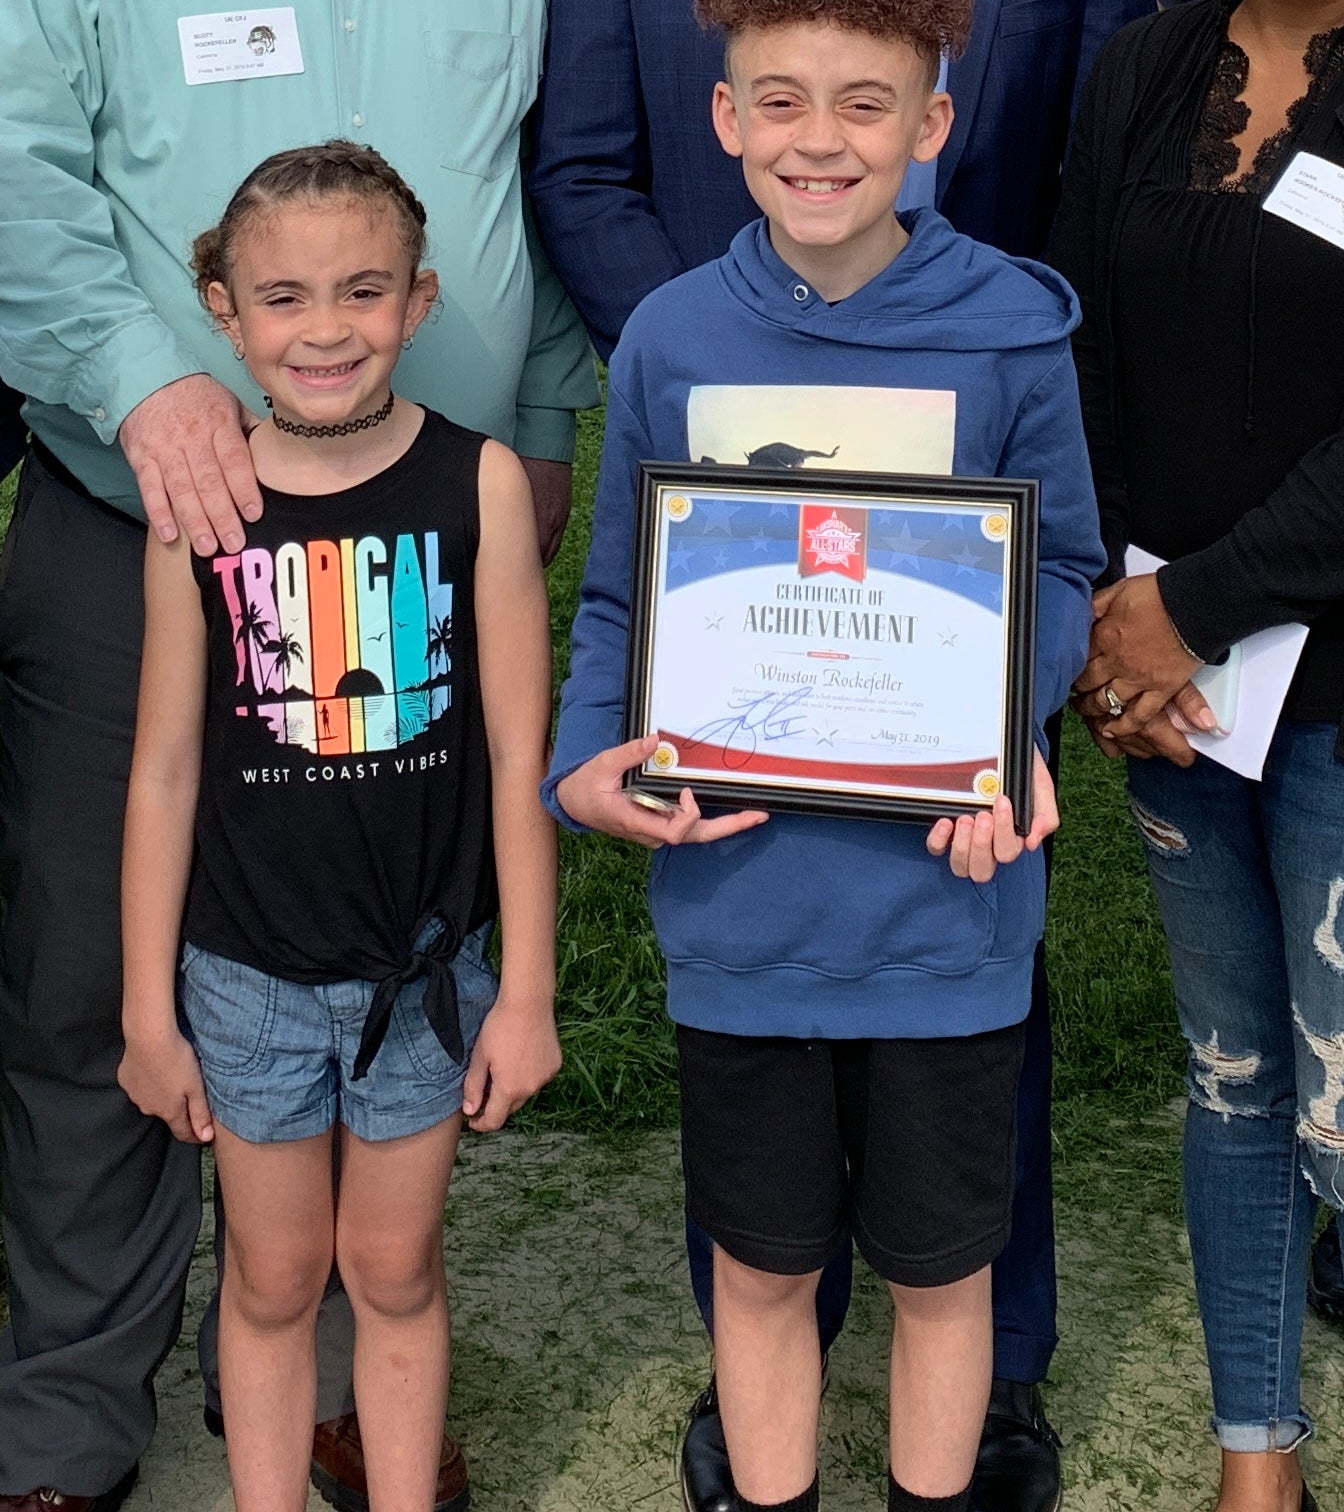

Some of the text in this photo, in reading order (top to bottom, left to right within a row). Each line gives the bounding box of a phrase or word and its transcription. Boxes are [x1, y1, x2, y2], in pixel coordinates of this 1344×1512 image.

[810, 538, 856, 553] ALL-STARS
[776, 583, 885, 606] CERTIFICATE OF
[743, 604, 918, 643] ACHIEVEMENT
[213, 531, 453, 756] TROPICAL
[755, 663, 817, 685] Winston
[822, 668, 903, 696] Rockefeller
[913, 735, 940, 746] 2019
[242, 750, 448, 783] WEST COAST VIBES
